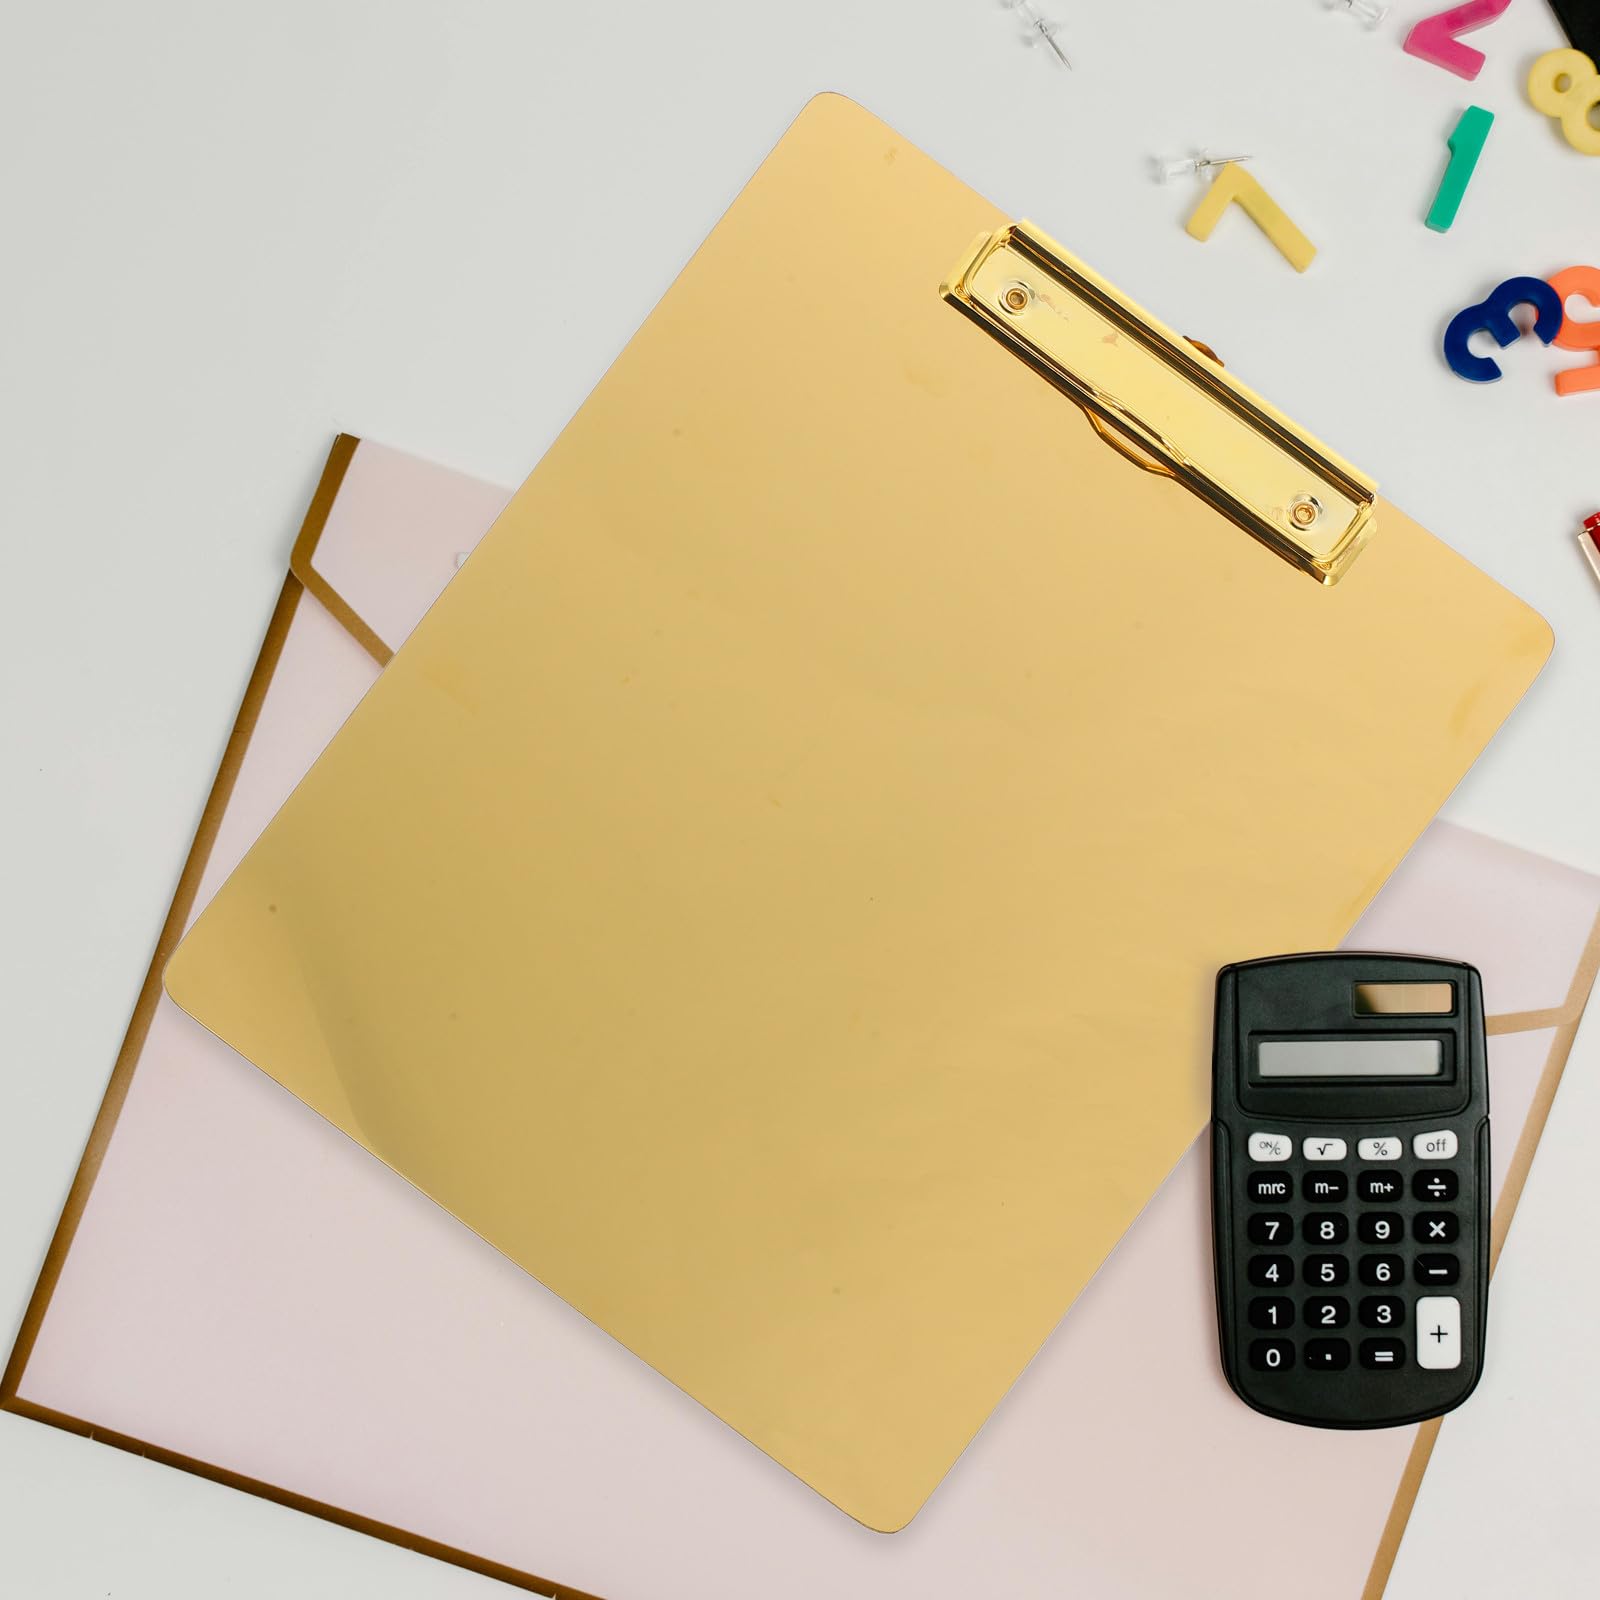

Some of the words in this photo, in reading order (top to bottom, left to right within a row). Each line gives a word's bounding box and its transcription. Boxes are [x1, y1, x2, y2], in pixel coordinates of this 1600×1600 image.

[1528, 48, 1600, 157] 8
[1425, 105, 1495, 233] 1
[1185, 160, 1317, 274] 7
[1444, 275, 1563, 384] 3
[1373, 1142, 1388, 1156] %
[1426, 1139, 1446, 1153] off
[1258, 1182, 1286, 1195] mrc
[1370, 1182, 1394, 1194] m+
[1265, 1221, 1280, 1240] 7
[1320, 1221, 1335, 1240] 8
[1375, 1220, 1390, 1240] 9
[1265, 1263, 1280, 1282] 4
[1320, 1263, 1335, 1282] 5
[1376, 1262, 1391, 1282] 6
[1267, 1306, 1277, 1325] 1
[1321, 1305, 1336, 1324] 2
[1376, 1304, 1392, 1323] 3
[1430, 1325, 1448, 1343] +
[1266, 1348, 1281, 1367] 0
[1374, 1351, 1394, 1362] =
